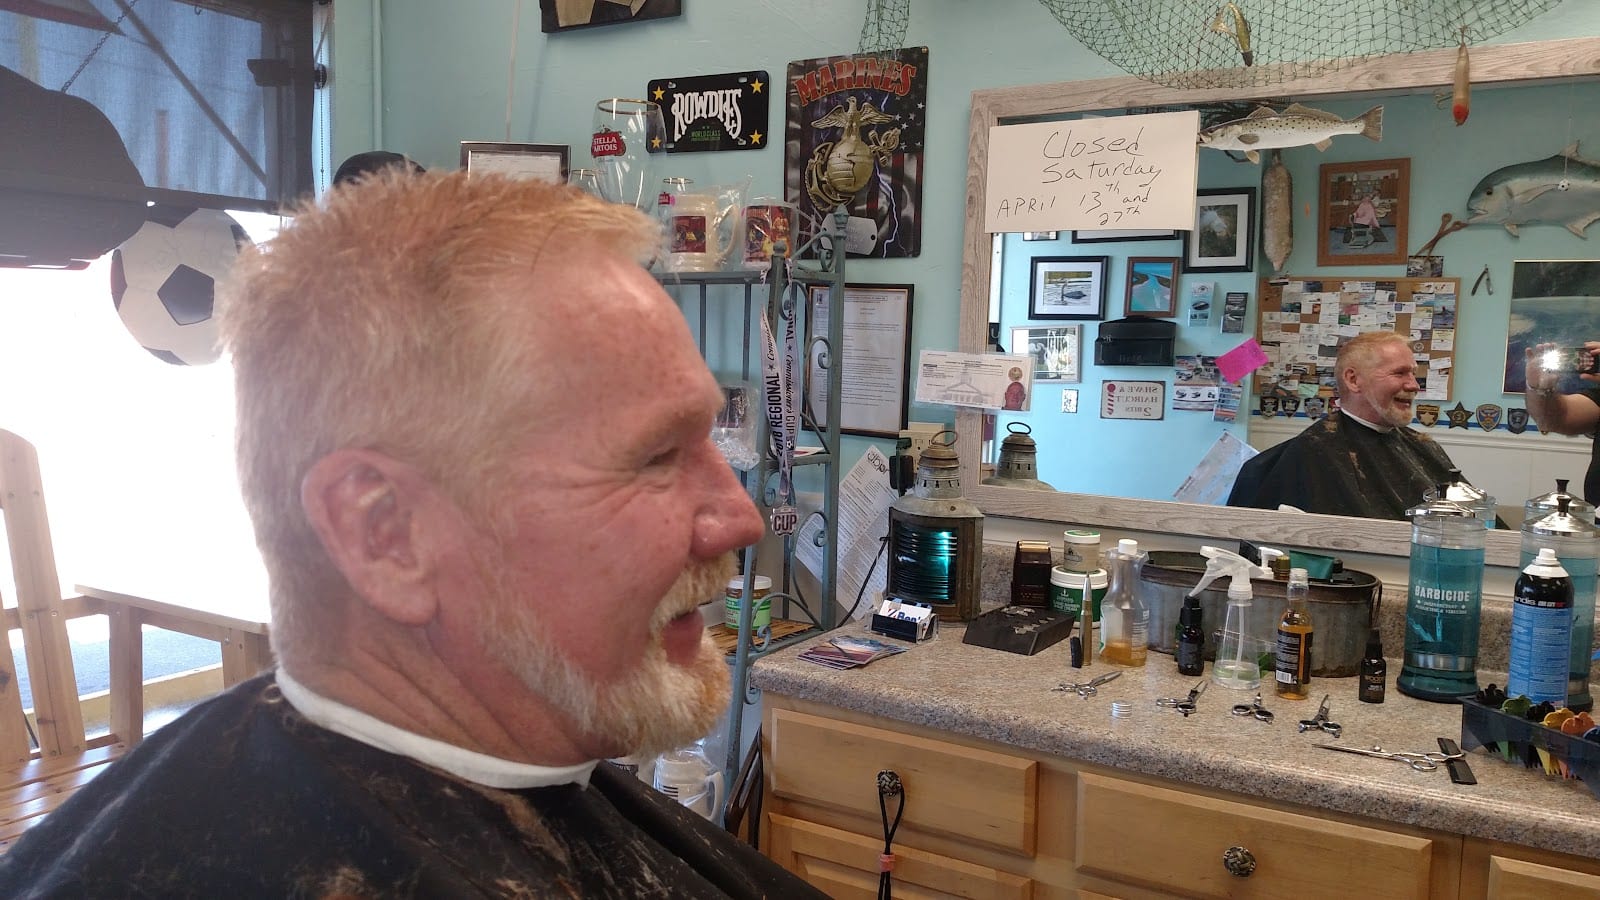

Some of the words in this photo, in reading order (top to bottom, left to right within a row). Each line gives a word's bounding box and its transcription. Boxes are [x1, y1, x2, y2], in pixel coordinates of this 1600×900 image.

[795, 57, 917, 107] MARINES
[671, 89, 742, 142] ROWDIES
[593, 136, 617, 145] STELLA
[593, 144, 617, 152] ARTOIS
[1043, 126, 1144, 159] Closed
[1042, 157, 1163, 188] Saturday
[1122, 187, 1151, 204] and
[766, 372, 783, 428] REGIONAL
[786, 415, 796, 435] CUP
[772, 430, 784, 457] 2018
[774, 514, 797, 532] CUP
[1414, 585, 1470, 602] BARBICIDE
